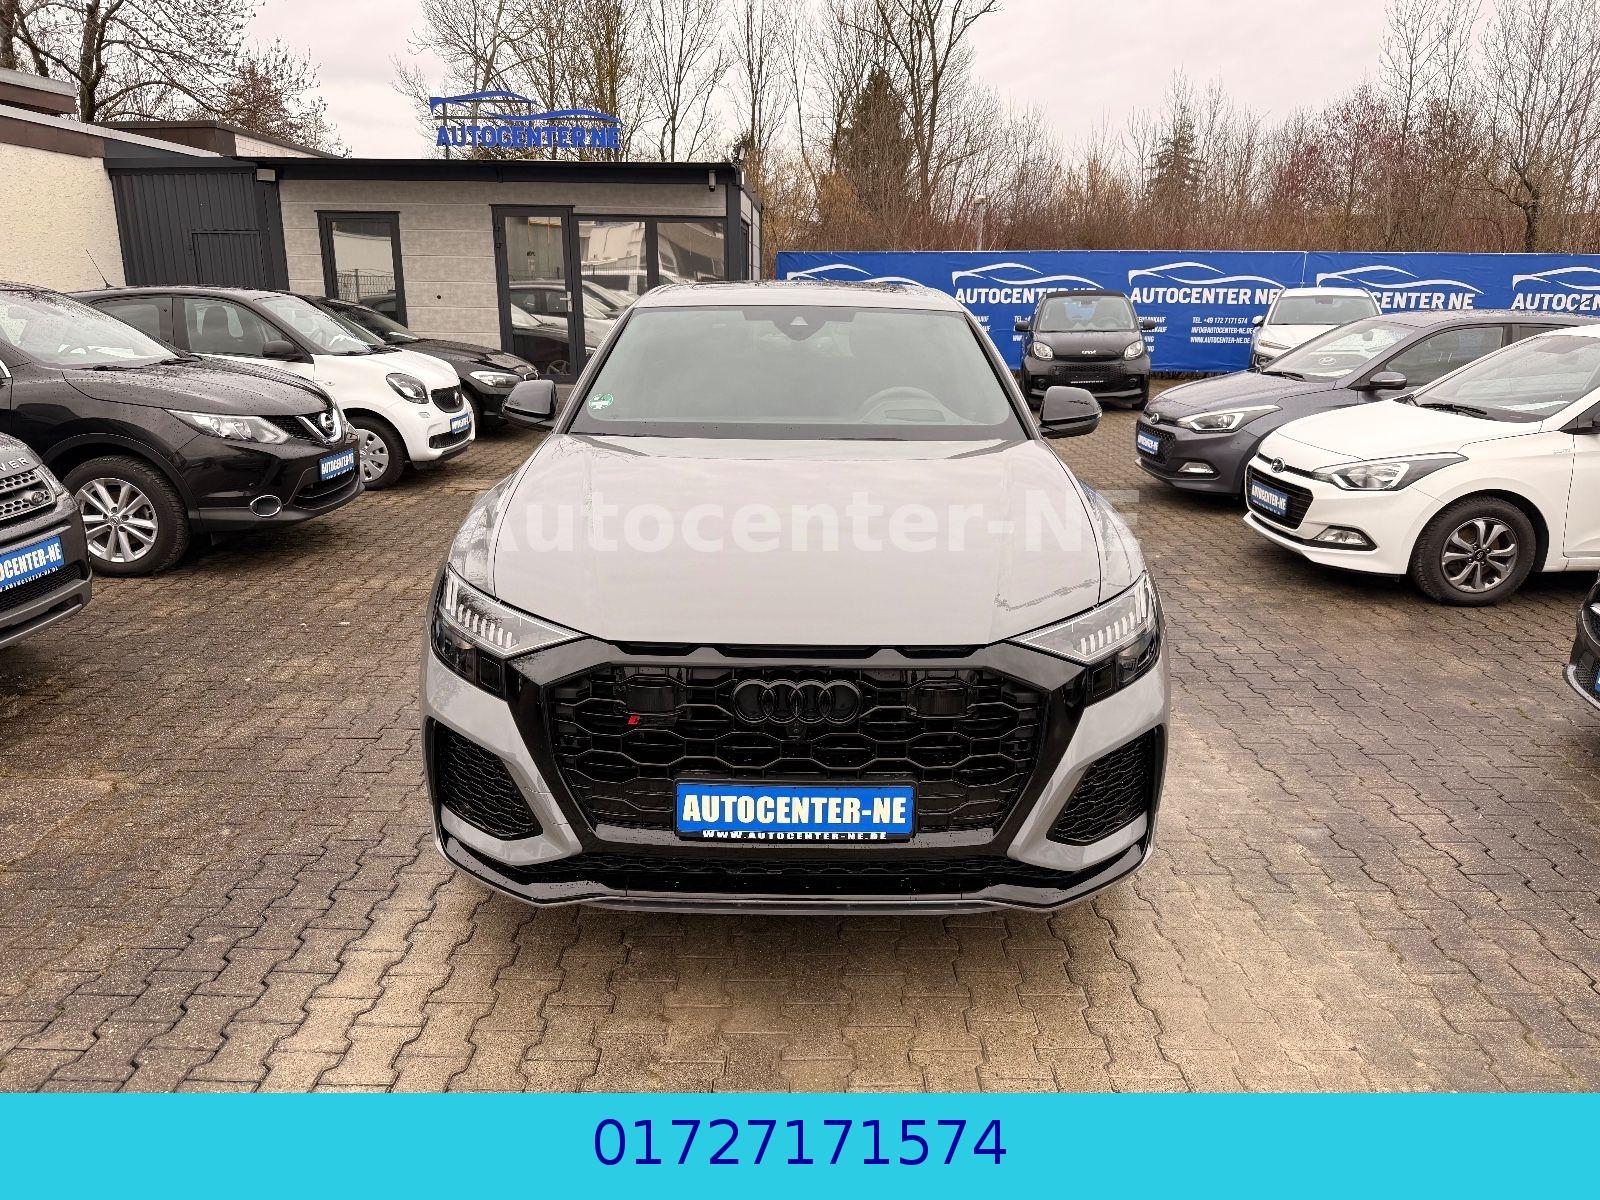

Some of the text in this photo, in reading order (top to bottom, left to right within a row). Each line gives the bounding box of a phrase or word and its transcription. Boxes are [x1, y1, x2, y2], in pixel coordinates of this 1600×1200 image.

[436, 125, 622, 150] AUTOCENTER NE
[1131, 287, 1251, 305] AUTOCENTER
[1448, 292, 1476, 309] NE
[682, 794, 907, 825] AUTOCENTER-NE
